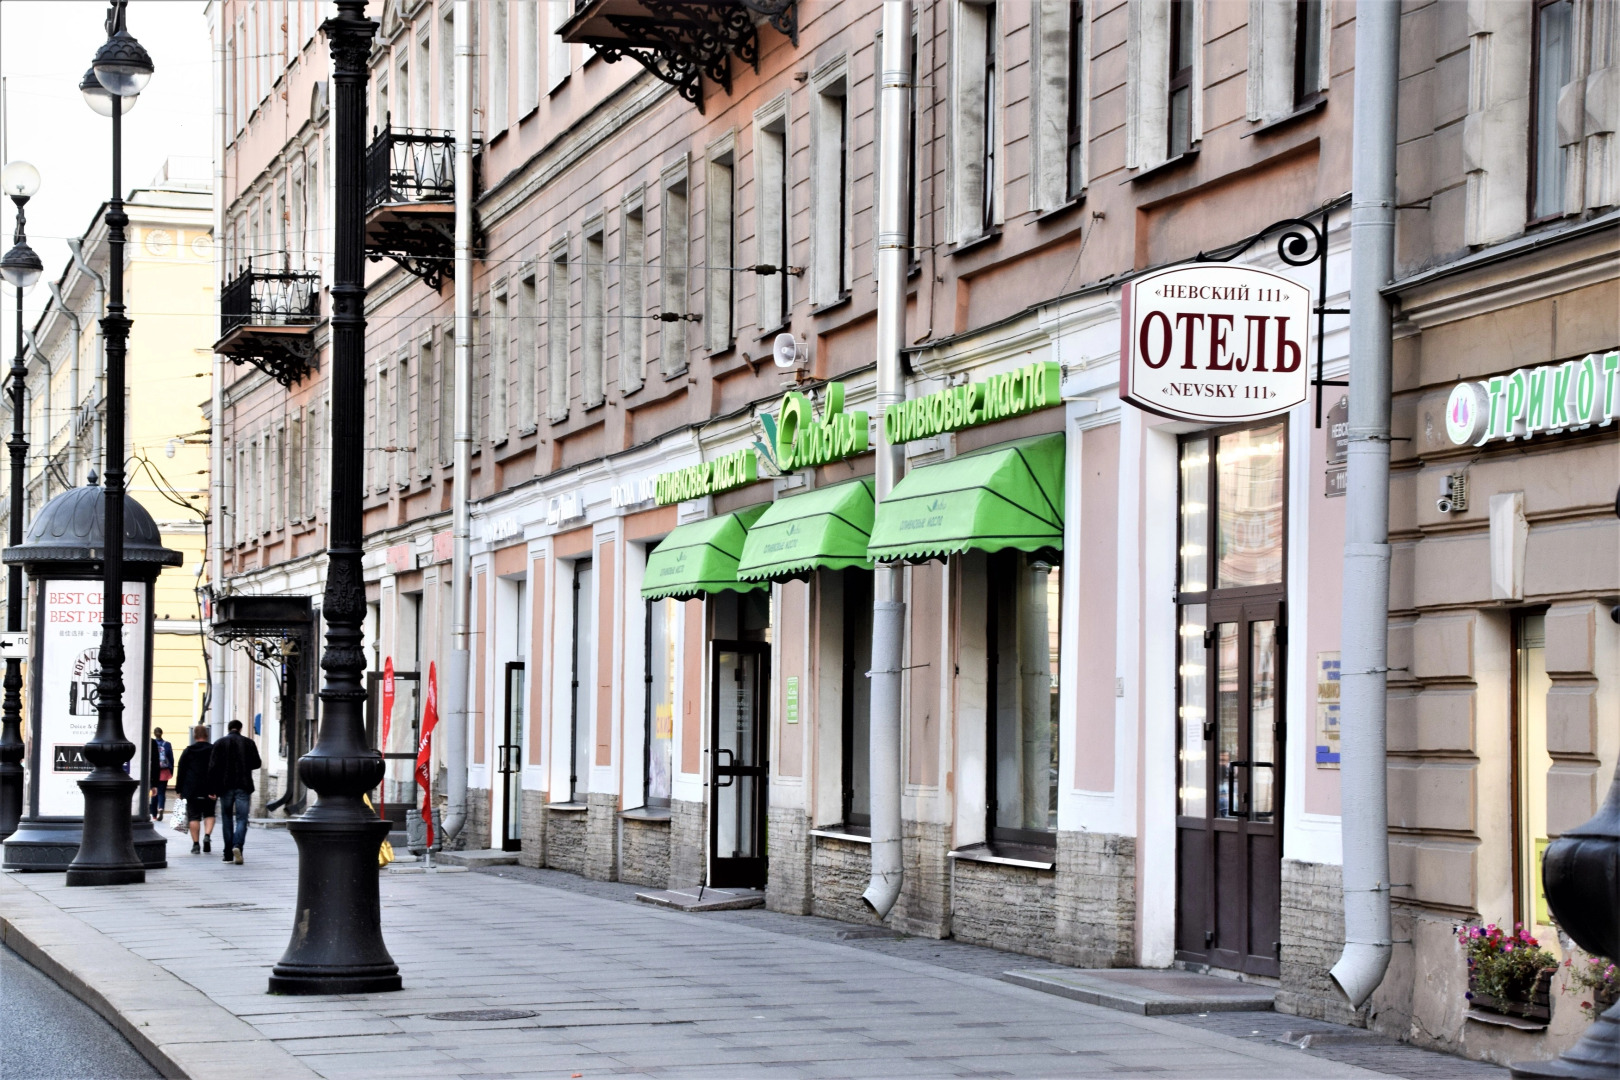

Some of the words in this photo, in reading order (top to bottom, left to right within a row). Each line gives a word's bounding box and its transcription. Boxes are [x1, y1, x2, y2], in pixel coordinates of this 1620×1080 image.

[1154, 283, 1250, 301] «НЕВСКИЙ
[1139, 310, 1302, 373] ОТЕЛЬ
[1161, 382, 1238, 398] «NEVSKY
[1488, 352, 1620, 437] ТРИКОТ
[49, 592, 84, 605] BEST
[86, 592, 141, 606] CHICE
[50, 610, 85, 623] BEST
